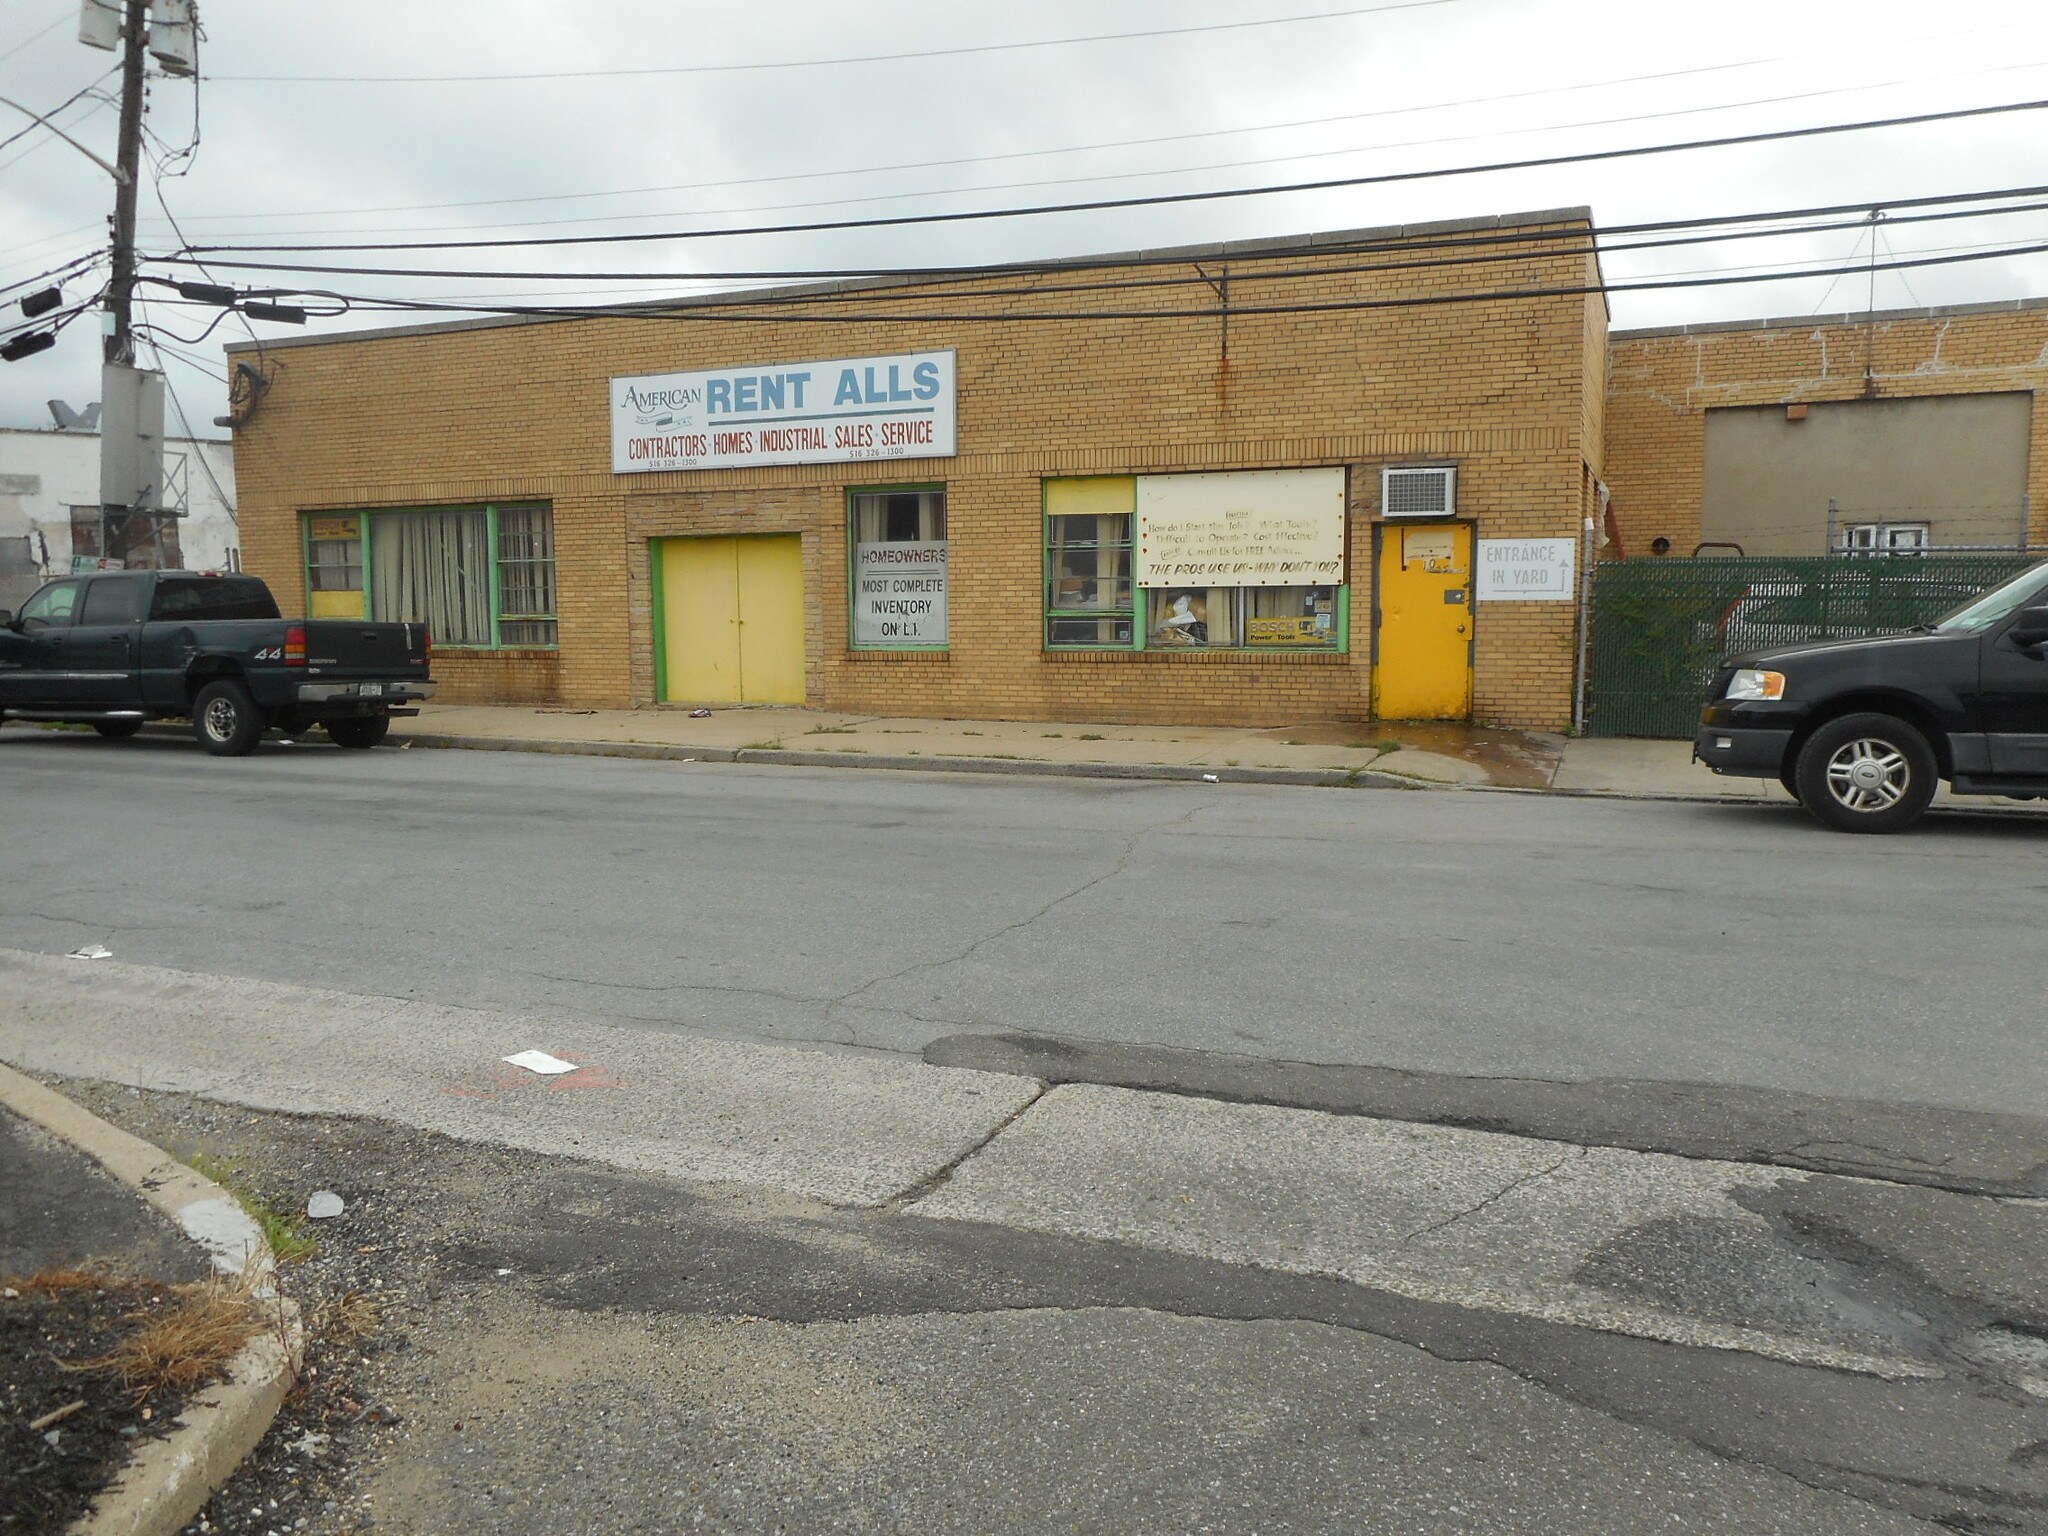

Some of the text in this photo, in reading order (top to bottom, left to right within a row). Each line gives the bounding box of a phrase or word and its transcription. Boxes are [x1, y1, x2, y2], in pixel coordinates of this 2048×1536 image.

[706, 362, 940, 414] RENT ALLS
[620, 386, 701, 412] AMERICAN
[628, 420, 934, 460] CONTRACTORS HOMES INDUSTRIAL SALES SERVICE
[866, 448, 904, 456] 326-1300
[649, 458, 697, 468] 516 326-1300
[1168, 523, 1178, 532] do
[862, 549, 946, 564] HOMEOWNERS
[1486, 546, 1555, 563] ENTRANCE
[1150, 564, 1172, 574] THE
[1174, 563, 1206, 575] PROS
[1208, 563, 1231, 574] USE
[1492, 569, 1548, 584] IN YARD
[862, 579, 943, 593] MOST COMPLETE
[871, 600, 932, 614] INVENTORY
[882, 622, 897, 636] ON
[1250, 621, 1296, 633] BOSCH
